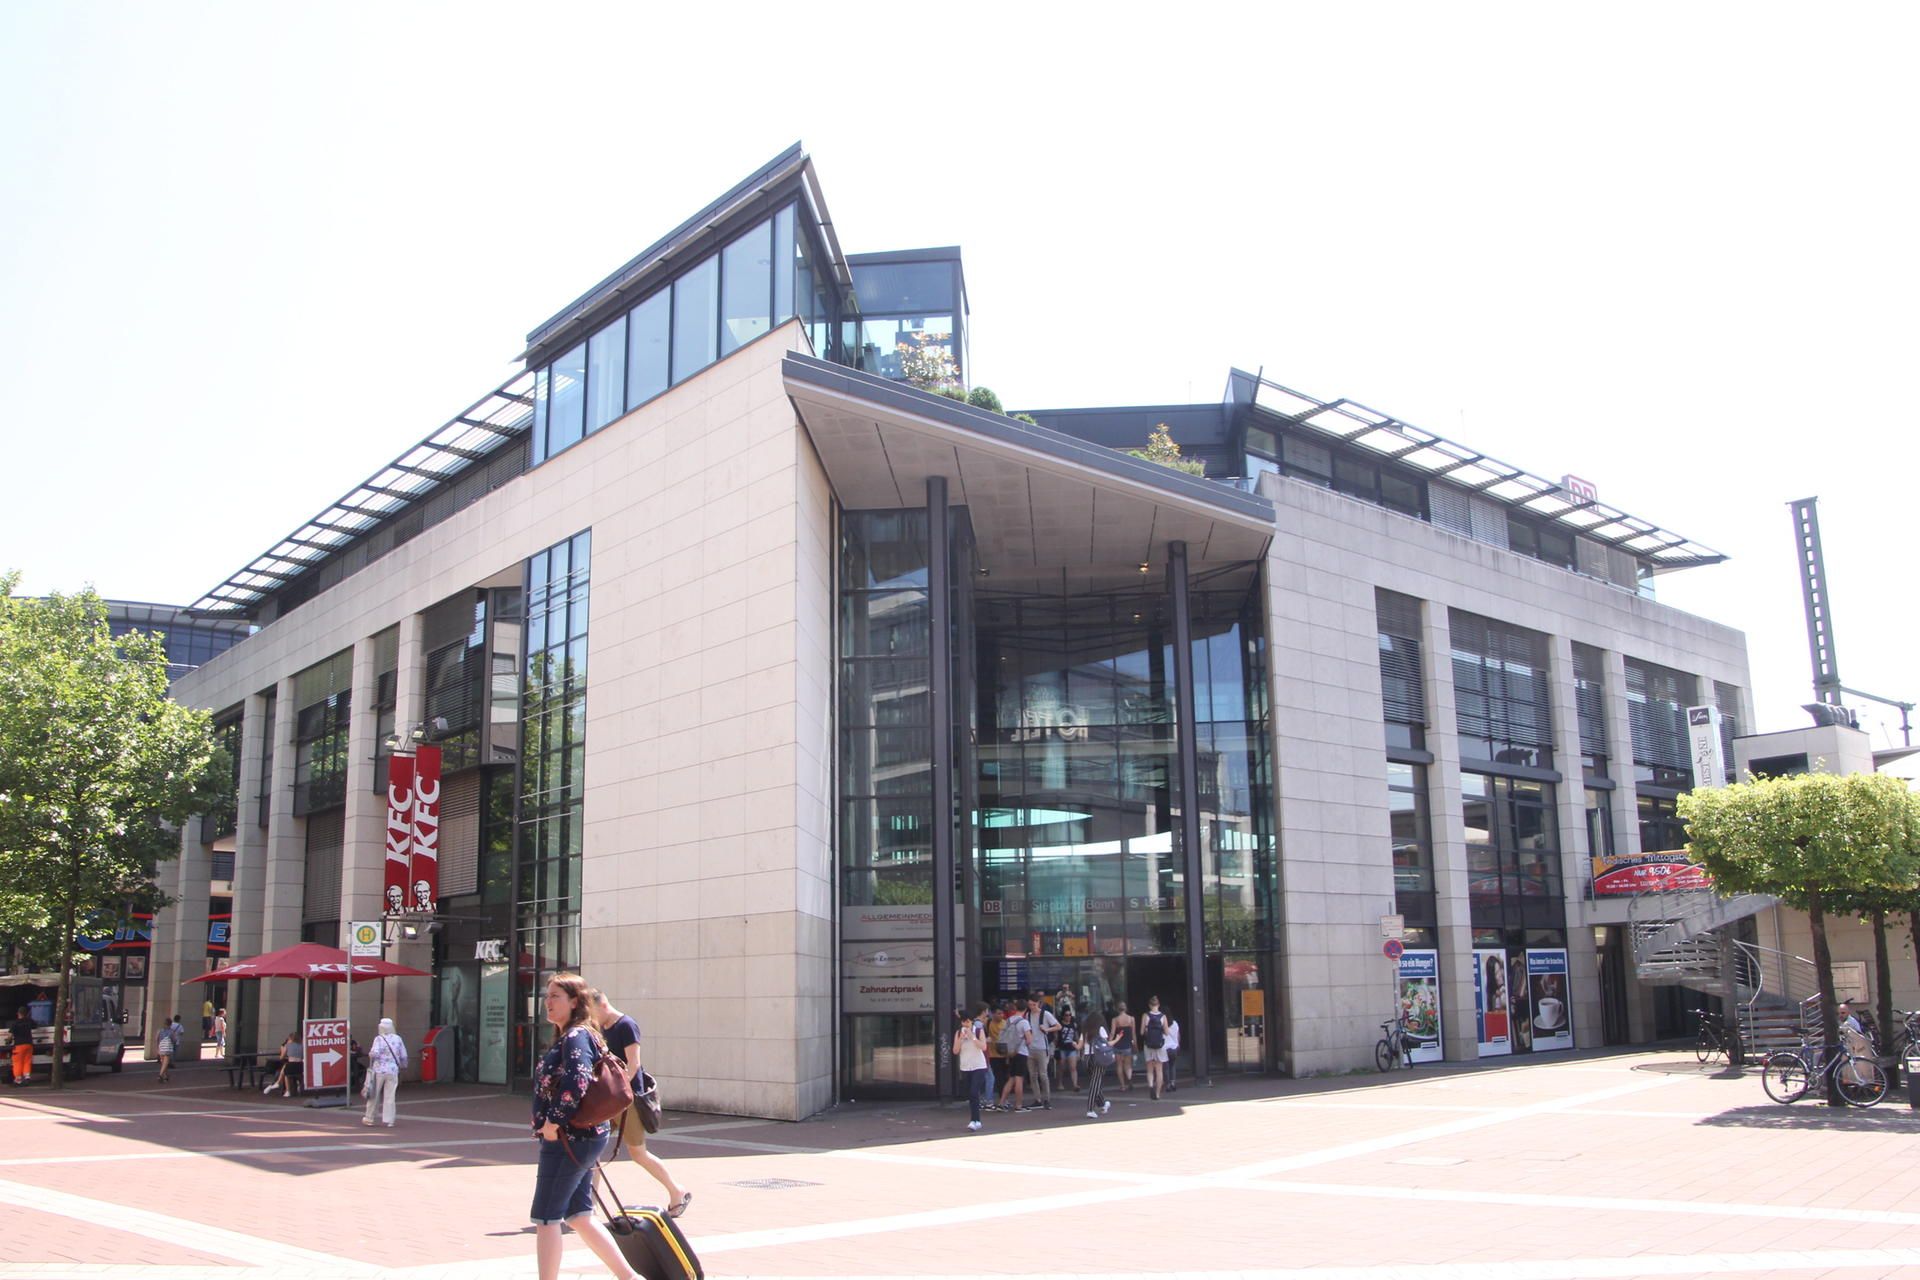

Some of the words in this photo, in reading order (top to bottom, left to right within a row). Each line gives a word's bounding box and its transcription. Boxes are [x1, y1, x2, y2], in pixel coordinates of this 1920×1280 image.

[386, 783, 413, 867] KFC
[412, 775, 440, 862] KFC
[475, 940, 506, 960] KFC
[307, 963, 378, 973] KFC
[860, 985, 923, 995] Zahnarztpraxis
[307, 1022, 346, 1037] KFC
[307, 1037, 346, 1047] EINGANG
